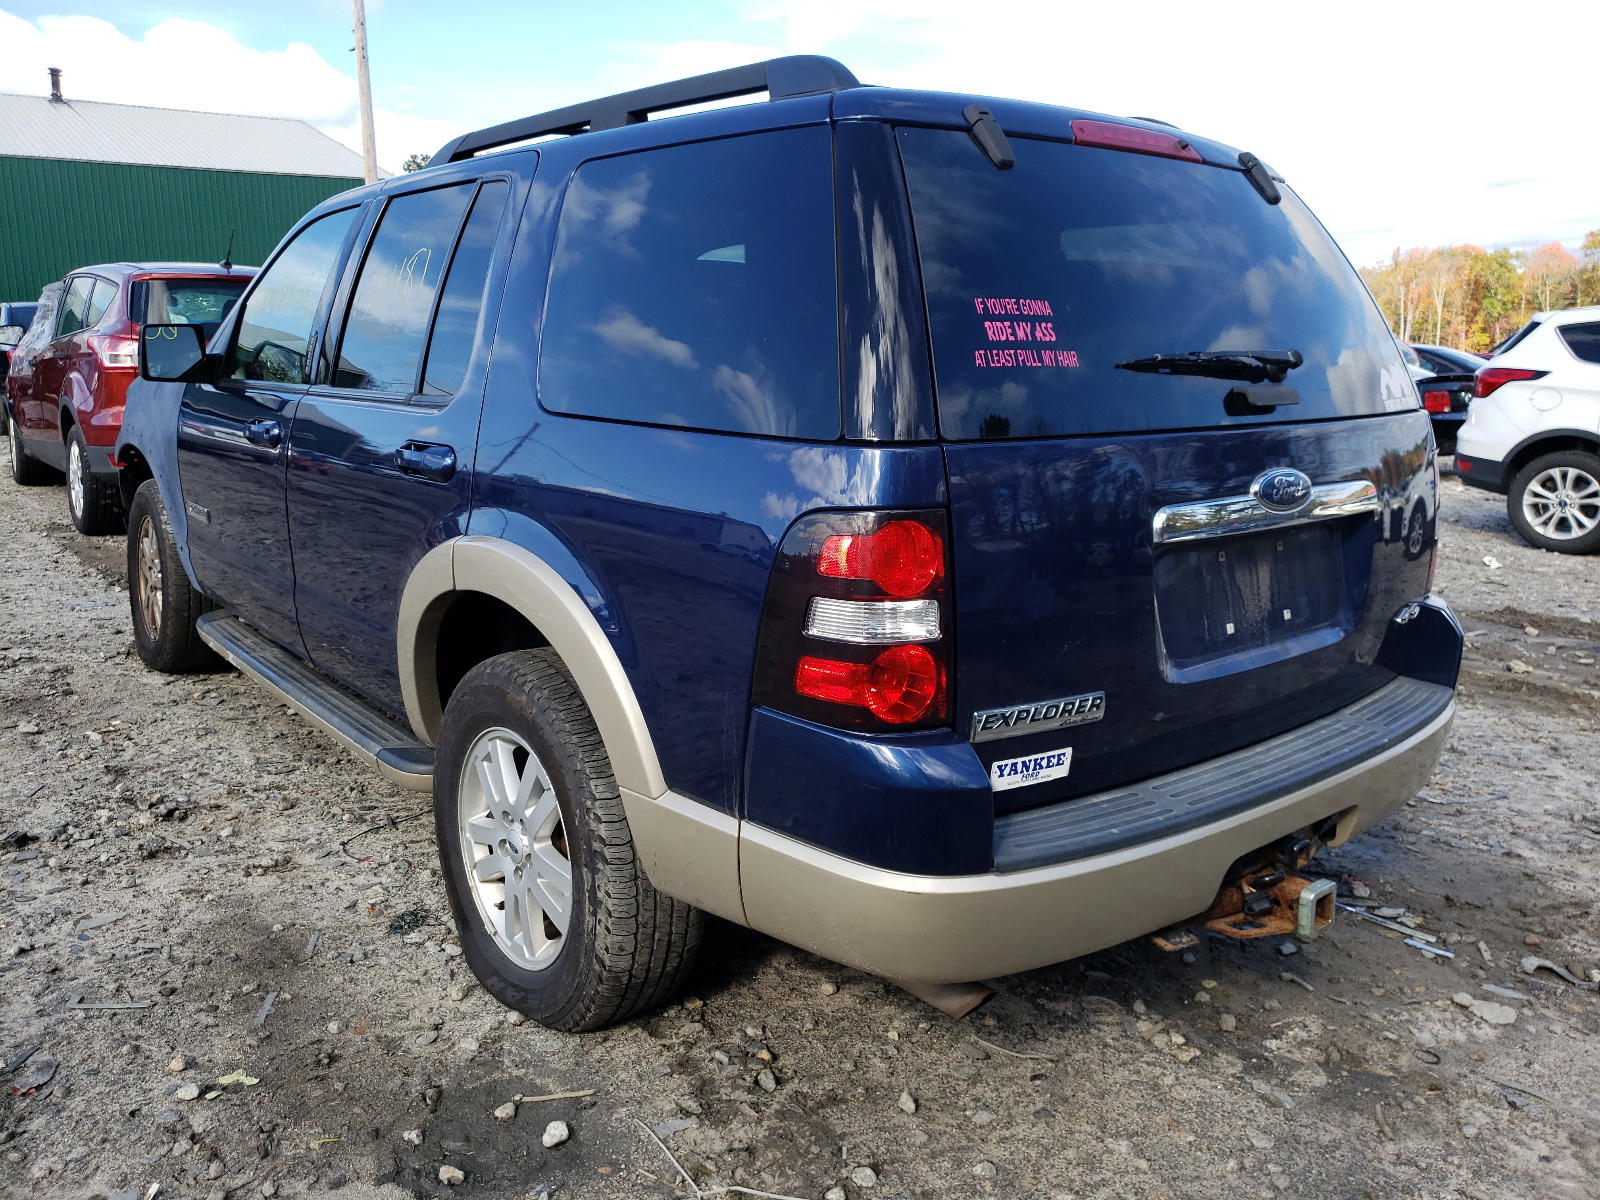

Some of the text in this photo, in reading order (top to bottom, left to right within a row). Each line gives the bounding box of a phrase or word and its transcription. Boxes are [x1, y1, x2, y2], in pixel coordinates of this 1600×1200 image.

[974, 298, 1053, 317] IF YOU'RE GONNA
[984, 321, 1057, 342] RIDE MY ASS
[975, 350, 1080, 368] AT LEAST PULL MY HAIR
[1272, 476, 1308, 500] Ford
[978, 696, 1104, 731] EXPLORER
[997, 752, 1067, 778] YANKEE
[1021, 771, 1040, 780] FORD
